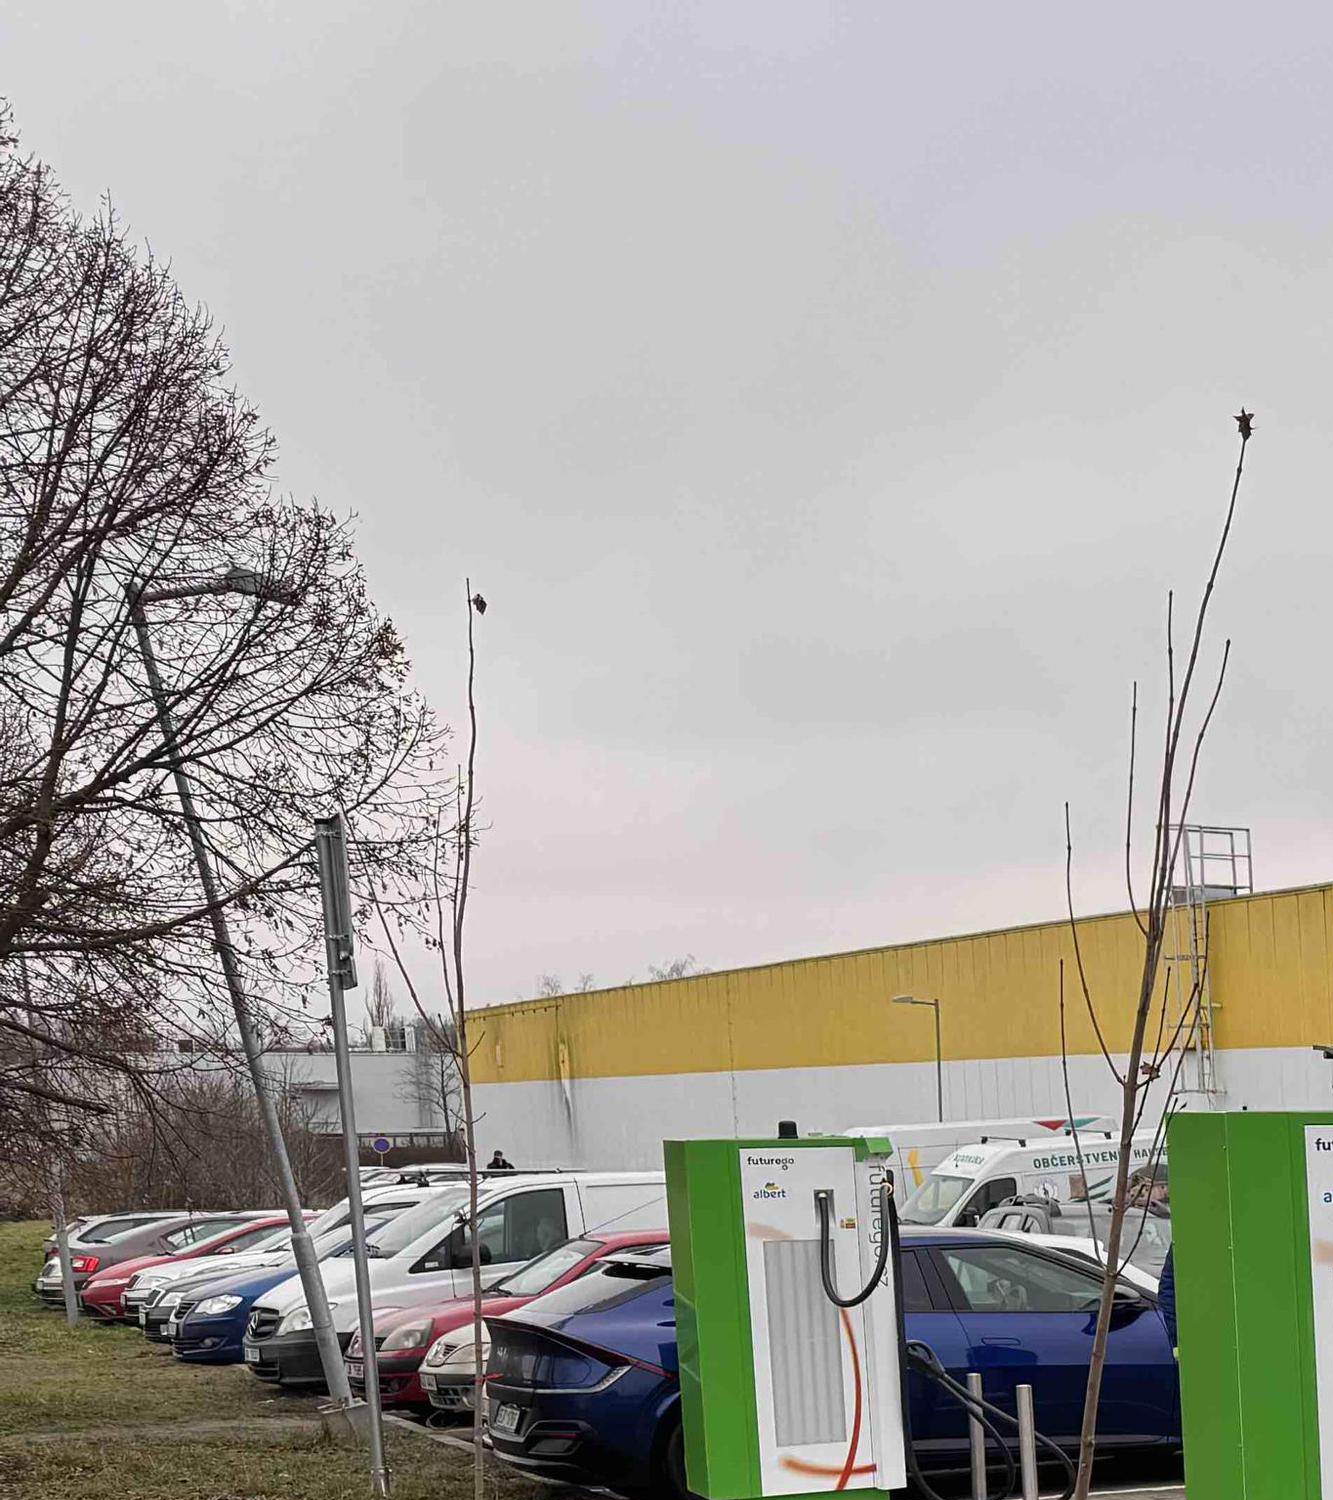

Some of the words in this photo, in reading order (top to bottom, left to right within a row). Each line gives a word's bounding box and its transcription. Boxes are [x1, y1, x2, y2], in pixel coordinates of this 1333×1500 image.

[747, 1156, 795, 1171] futurego
[1033, 1151, 1122, 1169] OBČERSTVEN
[753, 1190, 787, 1199] albert
